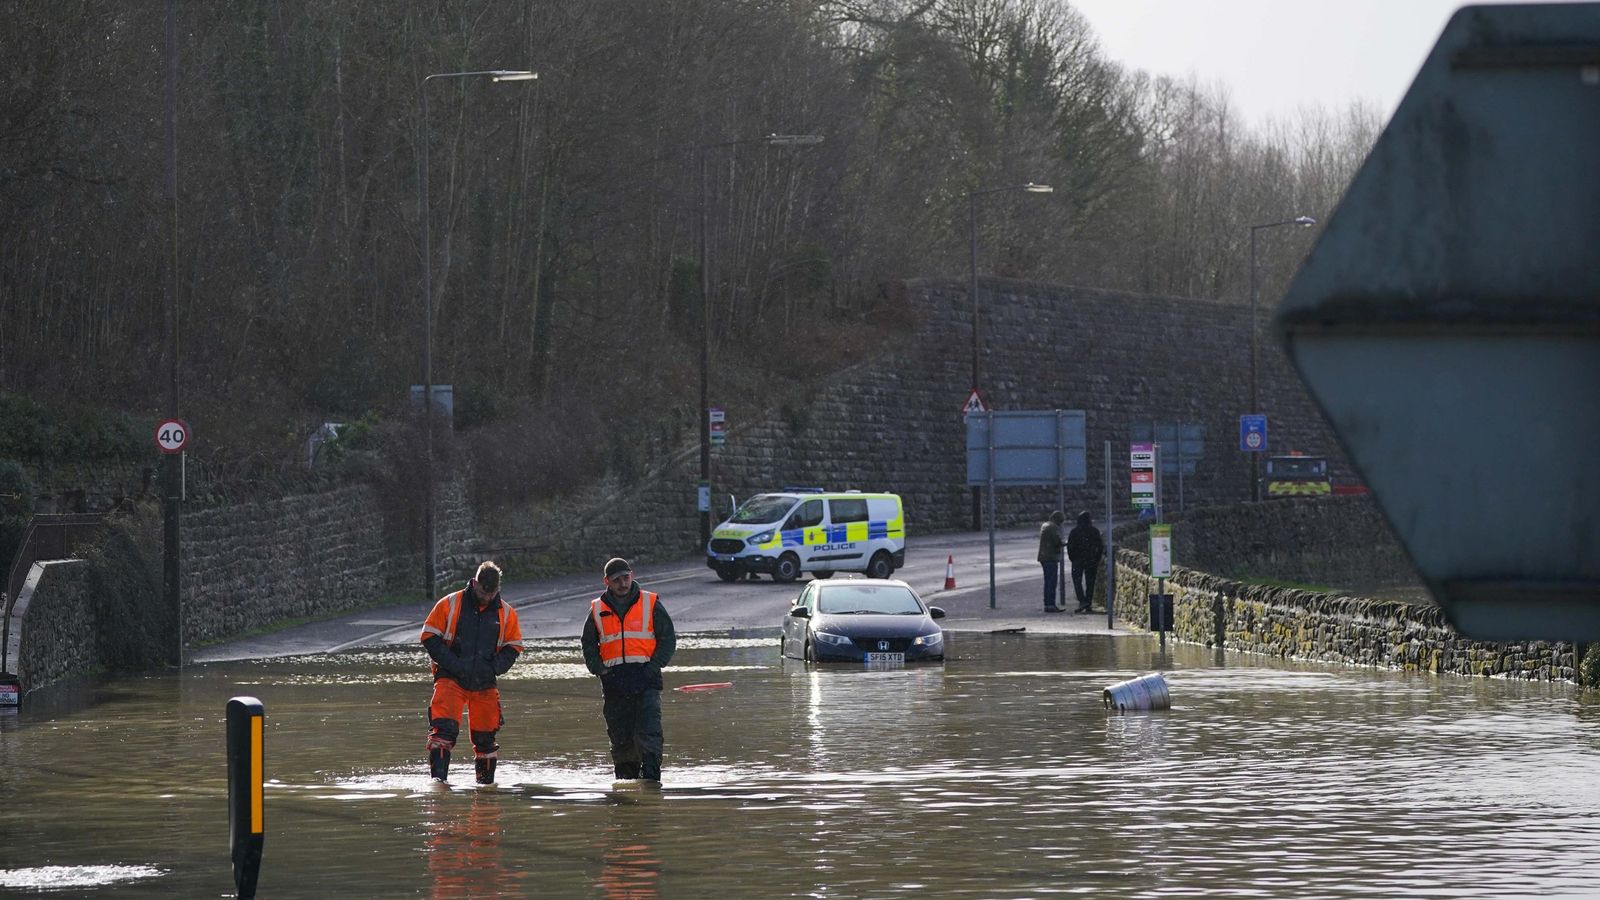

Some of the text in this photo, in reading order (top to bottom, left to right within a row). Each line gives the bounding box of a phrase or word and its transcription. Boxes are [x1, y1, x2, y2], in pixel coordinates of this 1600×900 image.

[160, 429, 184, 443] 40
[813, 542, 856, 552] POLICE
[870, 653, 887, 661] SF15
